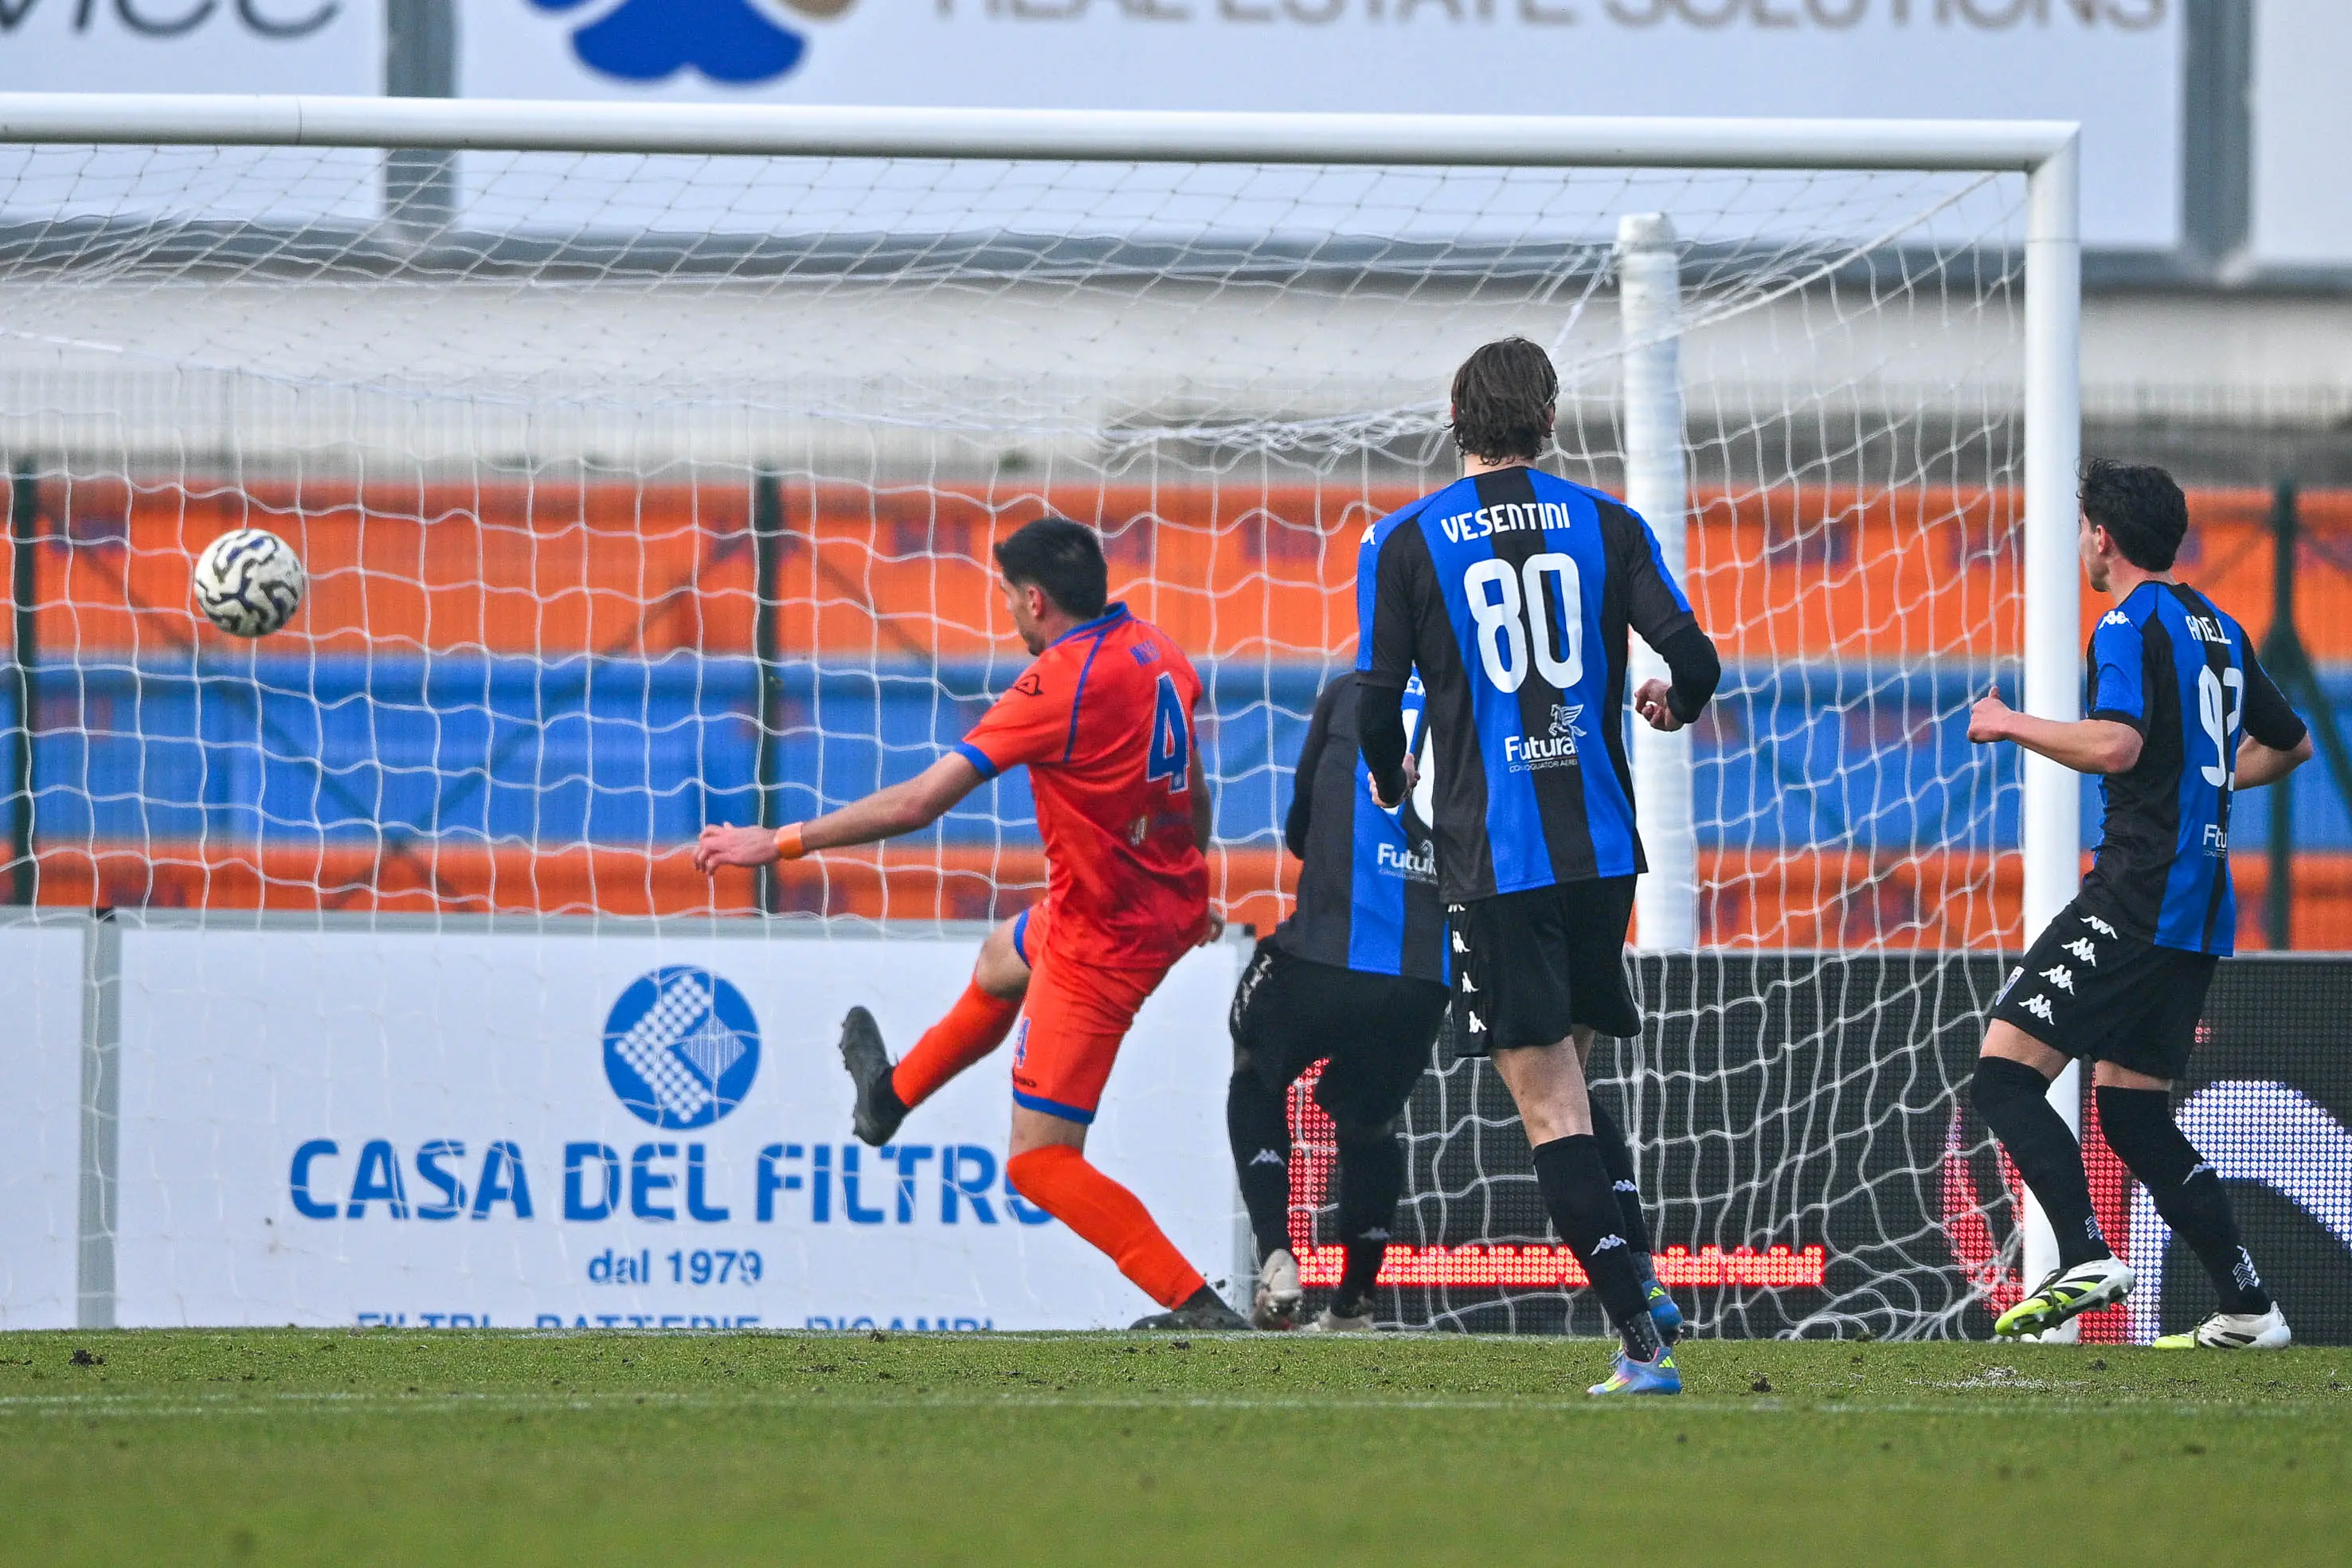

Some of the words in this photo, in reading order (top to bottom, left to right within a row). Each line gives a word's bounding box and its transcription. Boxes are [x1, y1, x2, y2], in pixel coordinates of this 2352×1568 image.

[1440, 502, 1571, 544] VESENTINI
[1463, 553, 1583, 693] 80
[1146, 671, 1190, 795] 4
[1505, 736, 1576, 762] Futura
[289, 1139, 534, 1221] CASA
[563, 1142, 730, 1223] DEL
[588, 1248, 649, 1284] dal
[667, 1249, 763, 1285] 1979
